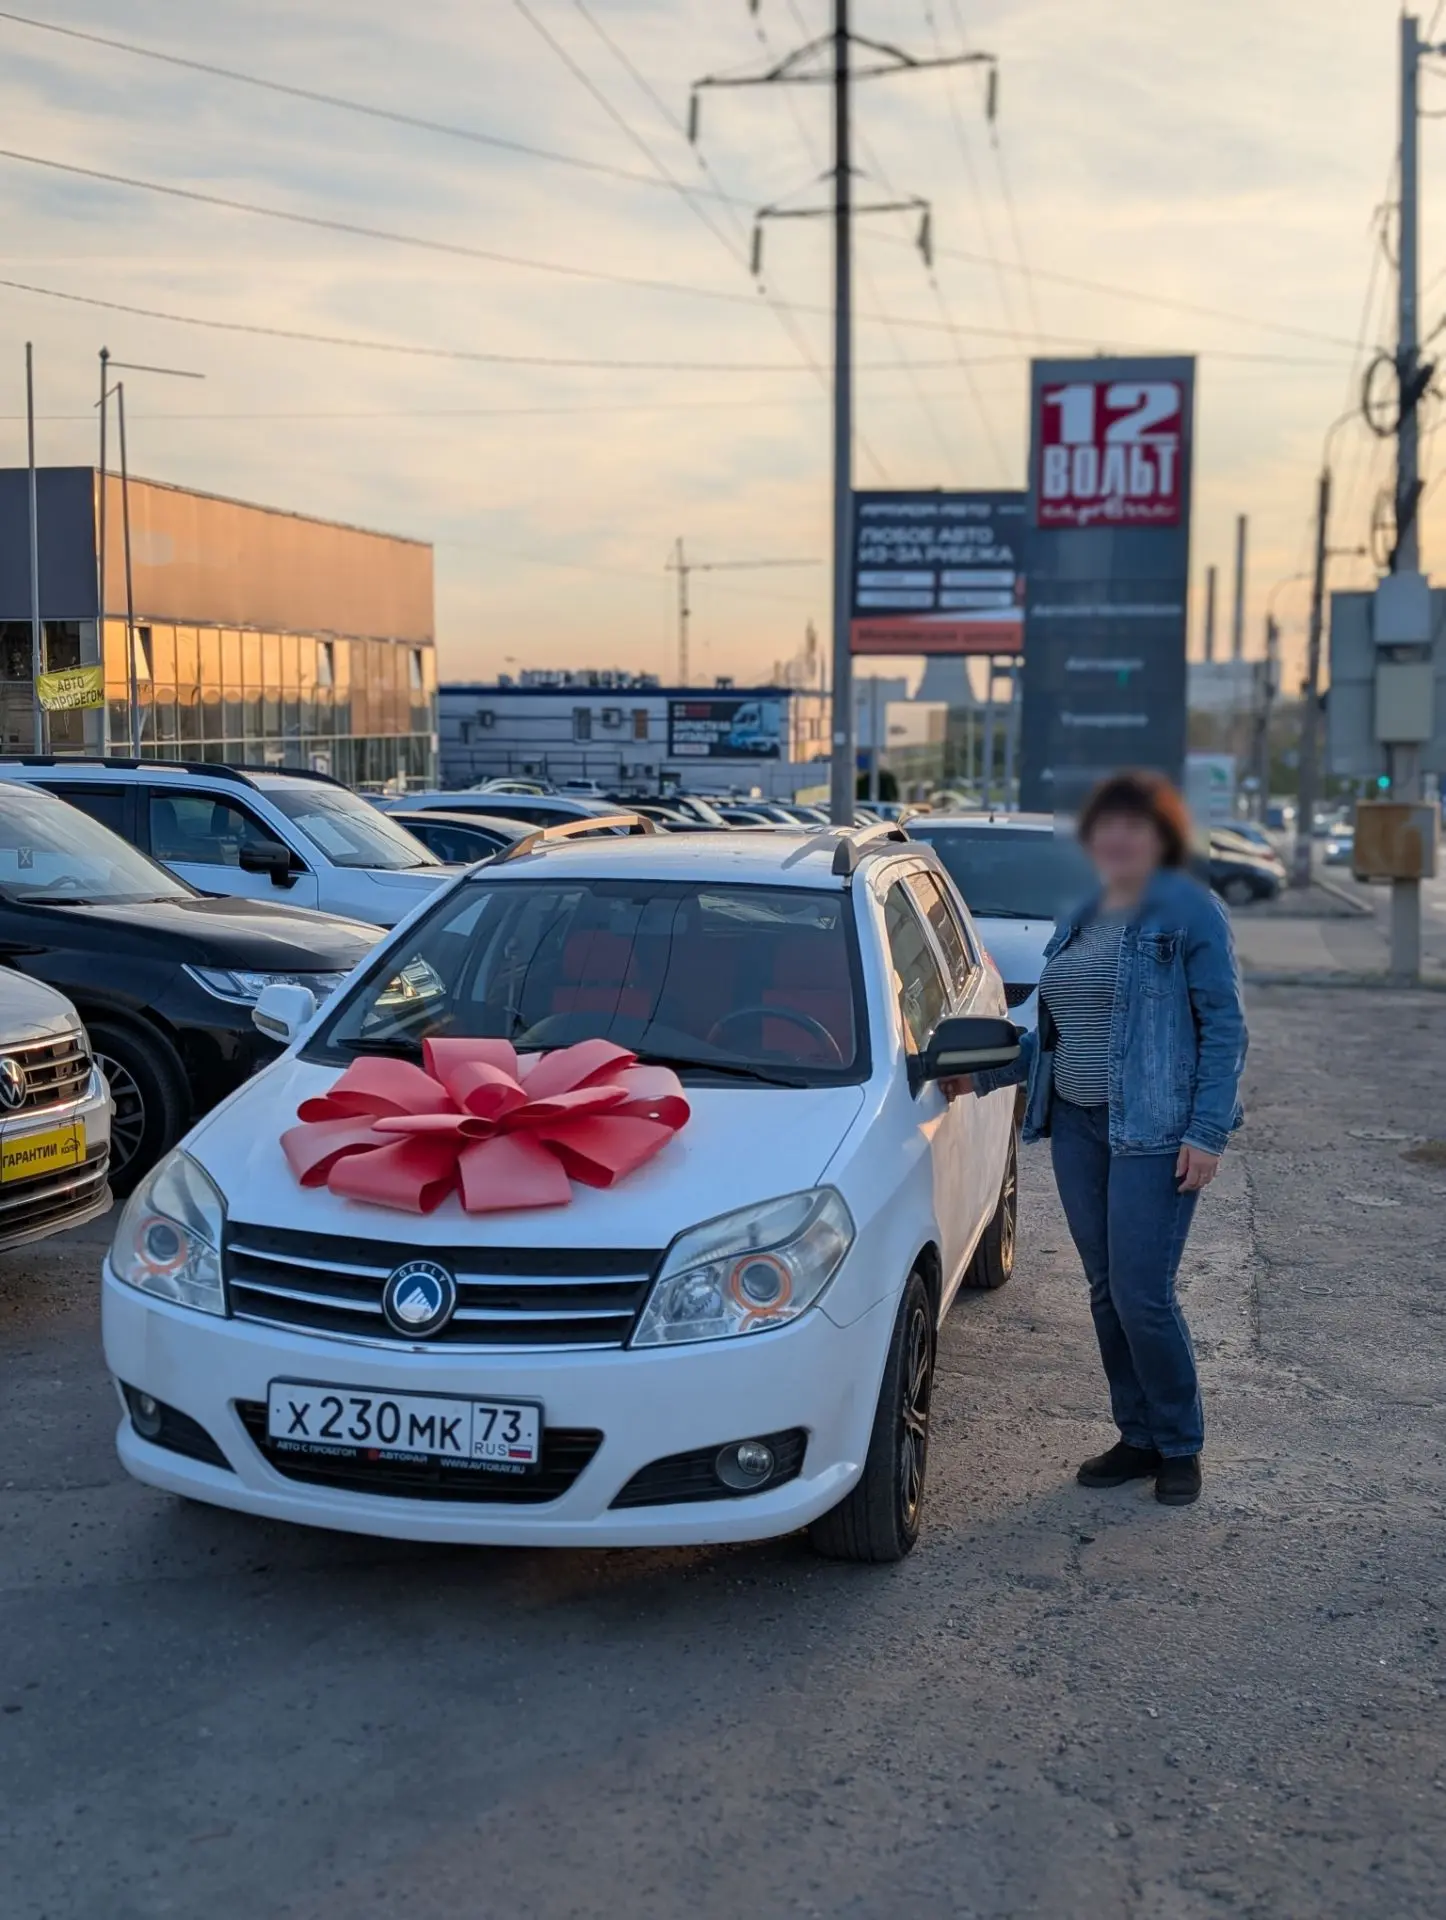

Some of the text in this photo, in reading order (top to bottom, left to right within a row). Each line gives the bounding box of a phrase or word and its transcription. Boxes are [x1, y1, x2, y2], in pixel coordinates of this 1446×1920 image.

[1045, 383, 1181, 443] 12
[1043, 445, 1178, 498] ВОЛЬТ
[938, 527, 994, 545] АВТО
[58, 677, 85, 692] АВТО
[2, 1144, 58, 1168] ГАРАНТИИ
[400, 1264, 446, 1282] GEELY
[288, 1396, 521, 1450] Х230МК 73
[474, 1441, 508, 1457] RUS
